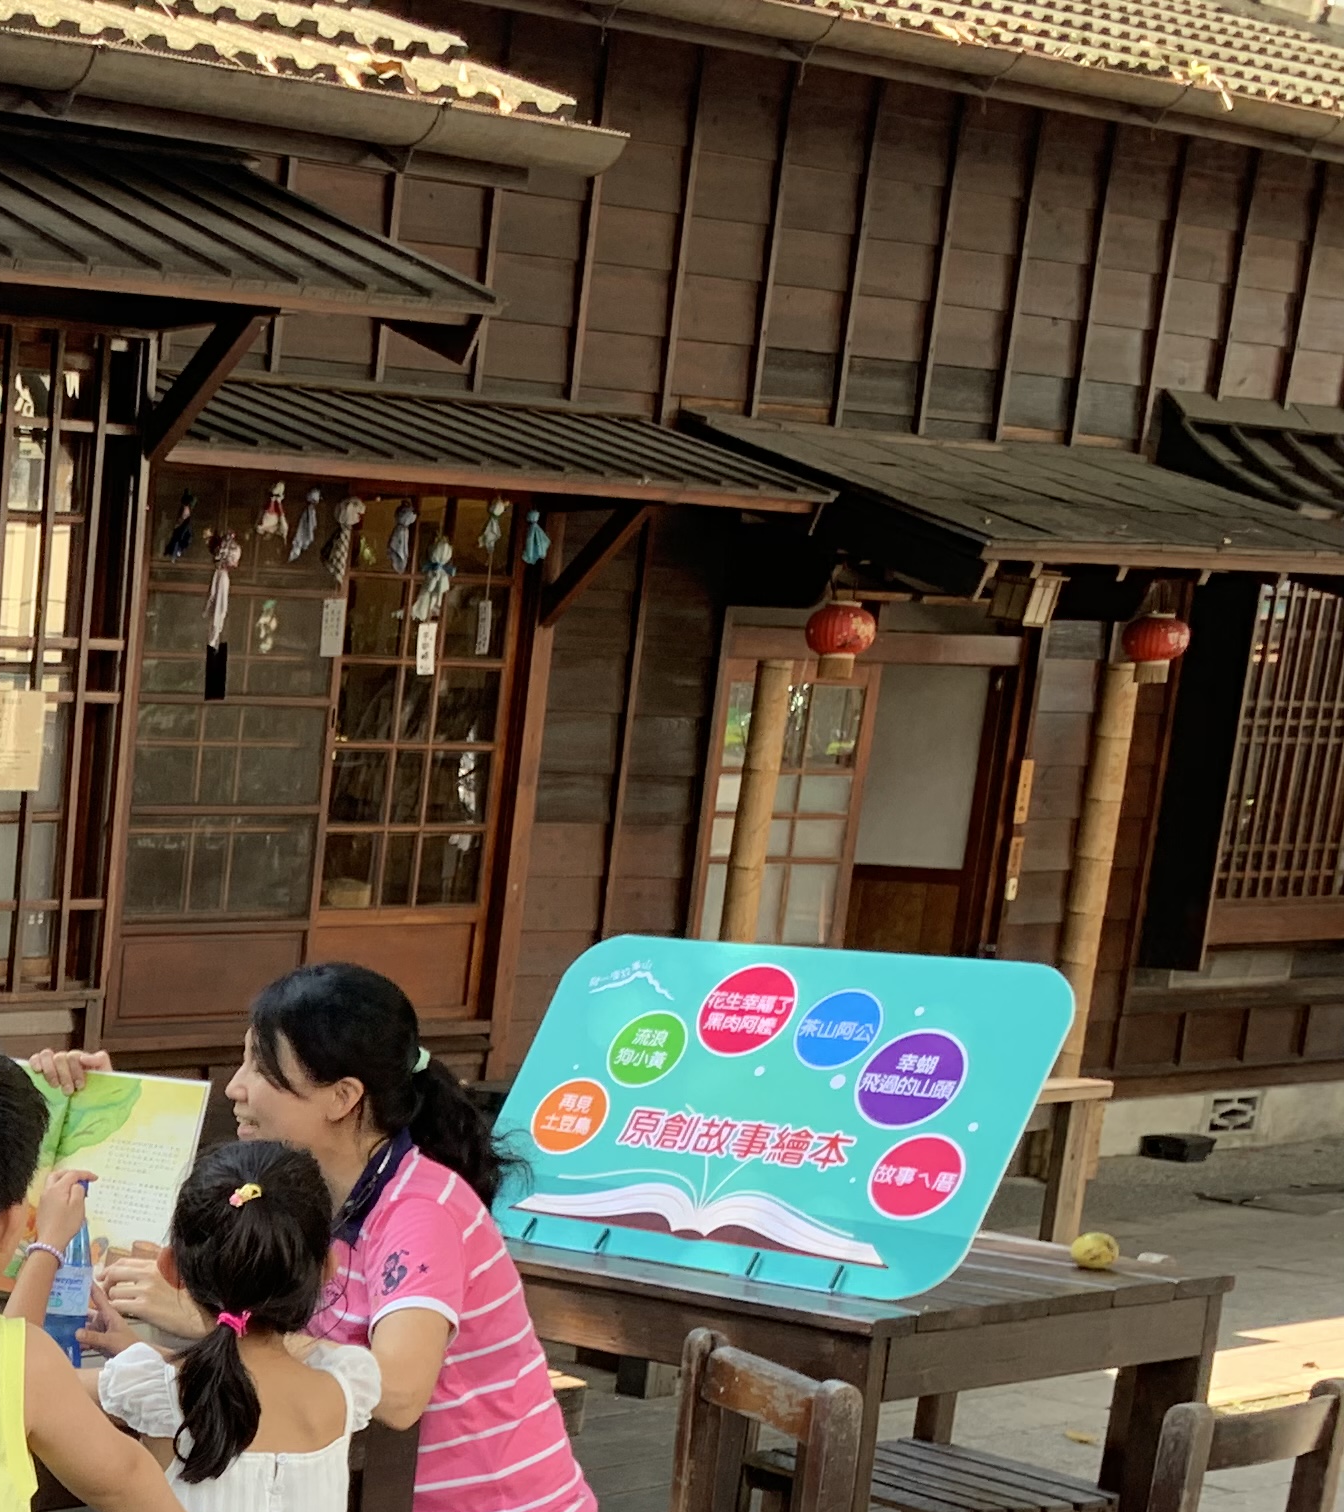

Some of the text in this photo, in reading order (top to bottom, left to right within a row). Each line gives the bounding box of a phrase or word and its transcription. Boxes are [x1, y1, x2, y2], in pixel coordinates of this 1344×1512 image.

[631, 1027, 670, 1048] 流浪
[798, 1017, 876, 1043] 茶山阿公
[860, 1072, 958, 1100] 飛過的山頭
[558, 1093, 594, 1115] 再見
[617, 1107, 856, 1170] 原創故事繪本
